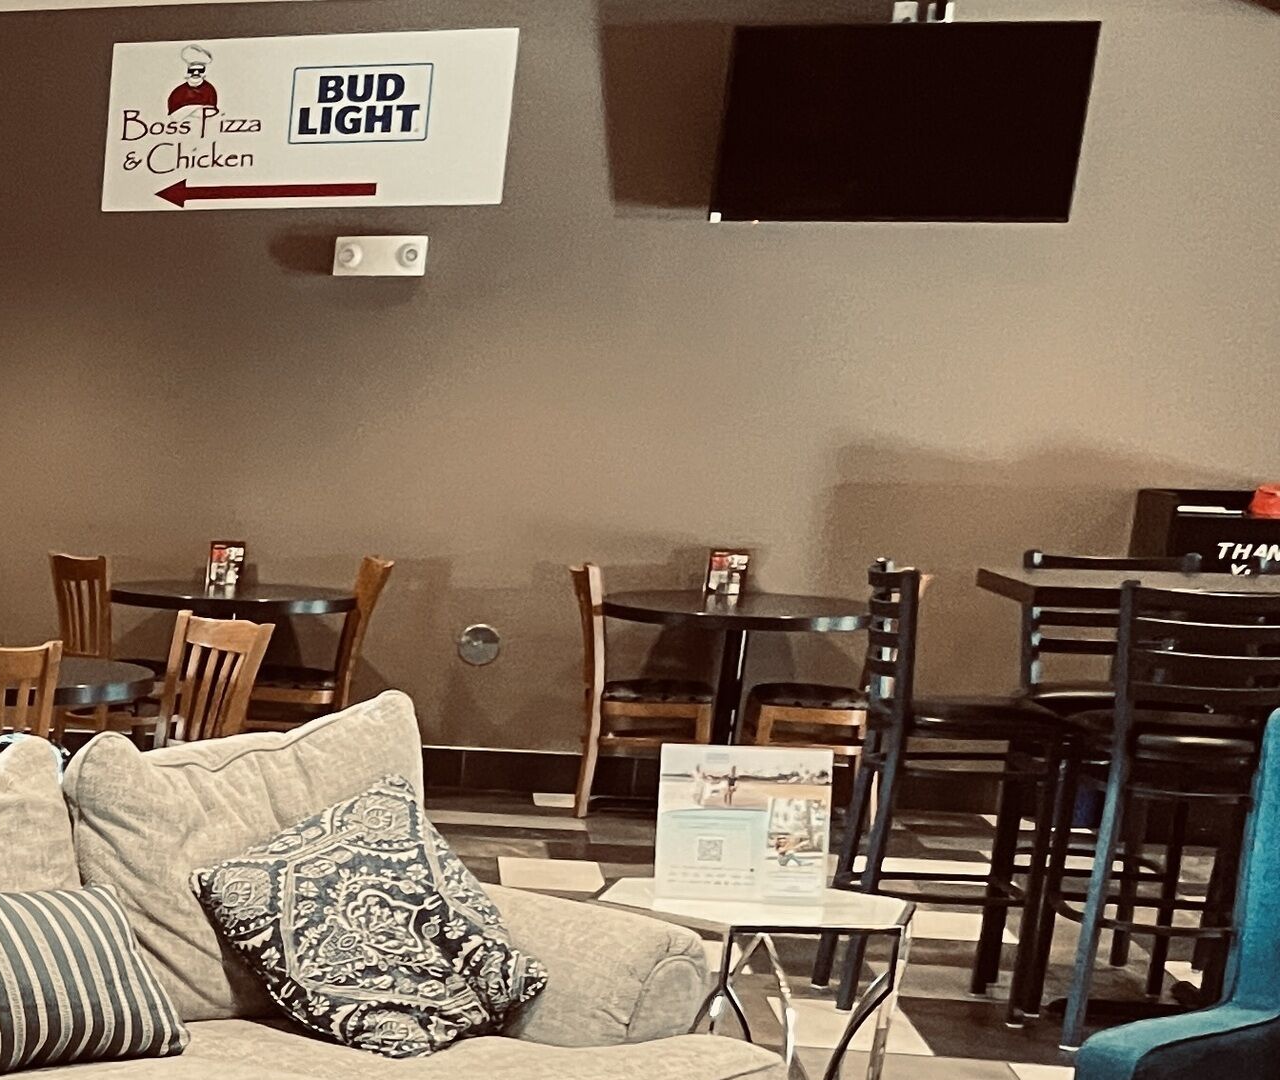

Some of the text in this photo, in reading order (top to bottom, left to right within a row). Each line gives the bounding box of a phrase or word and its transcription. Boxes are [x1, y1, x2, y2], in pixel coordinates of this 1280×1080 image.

[317, 73, 406, 104] BUD
[121, 107, 262, 141] Boss Pizza
[297, 104, 421, 135] LIGHT
[122, 141, 254, 174] & Chicken
